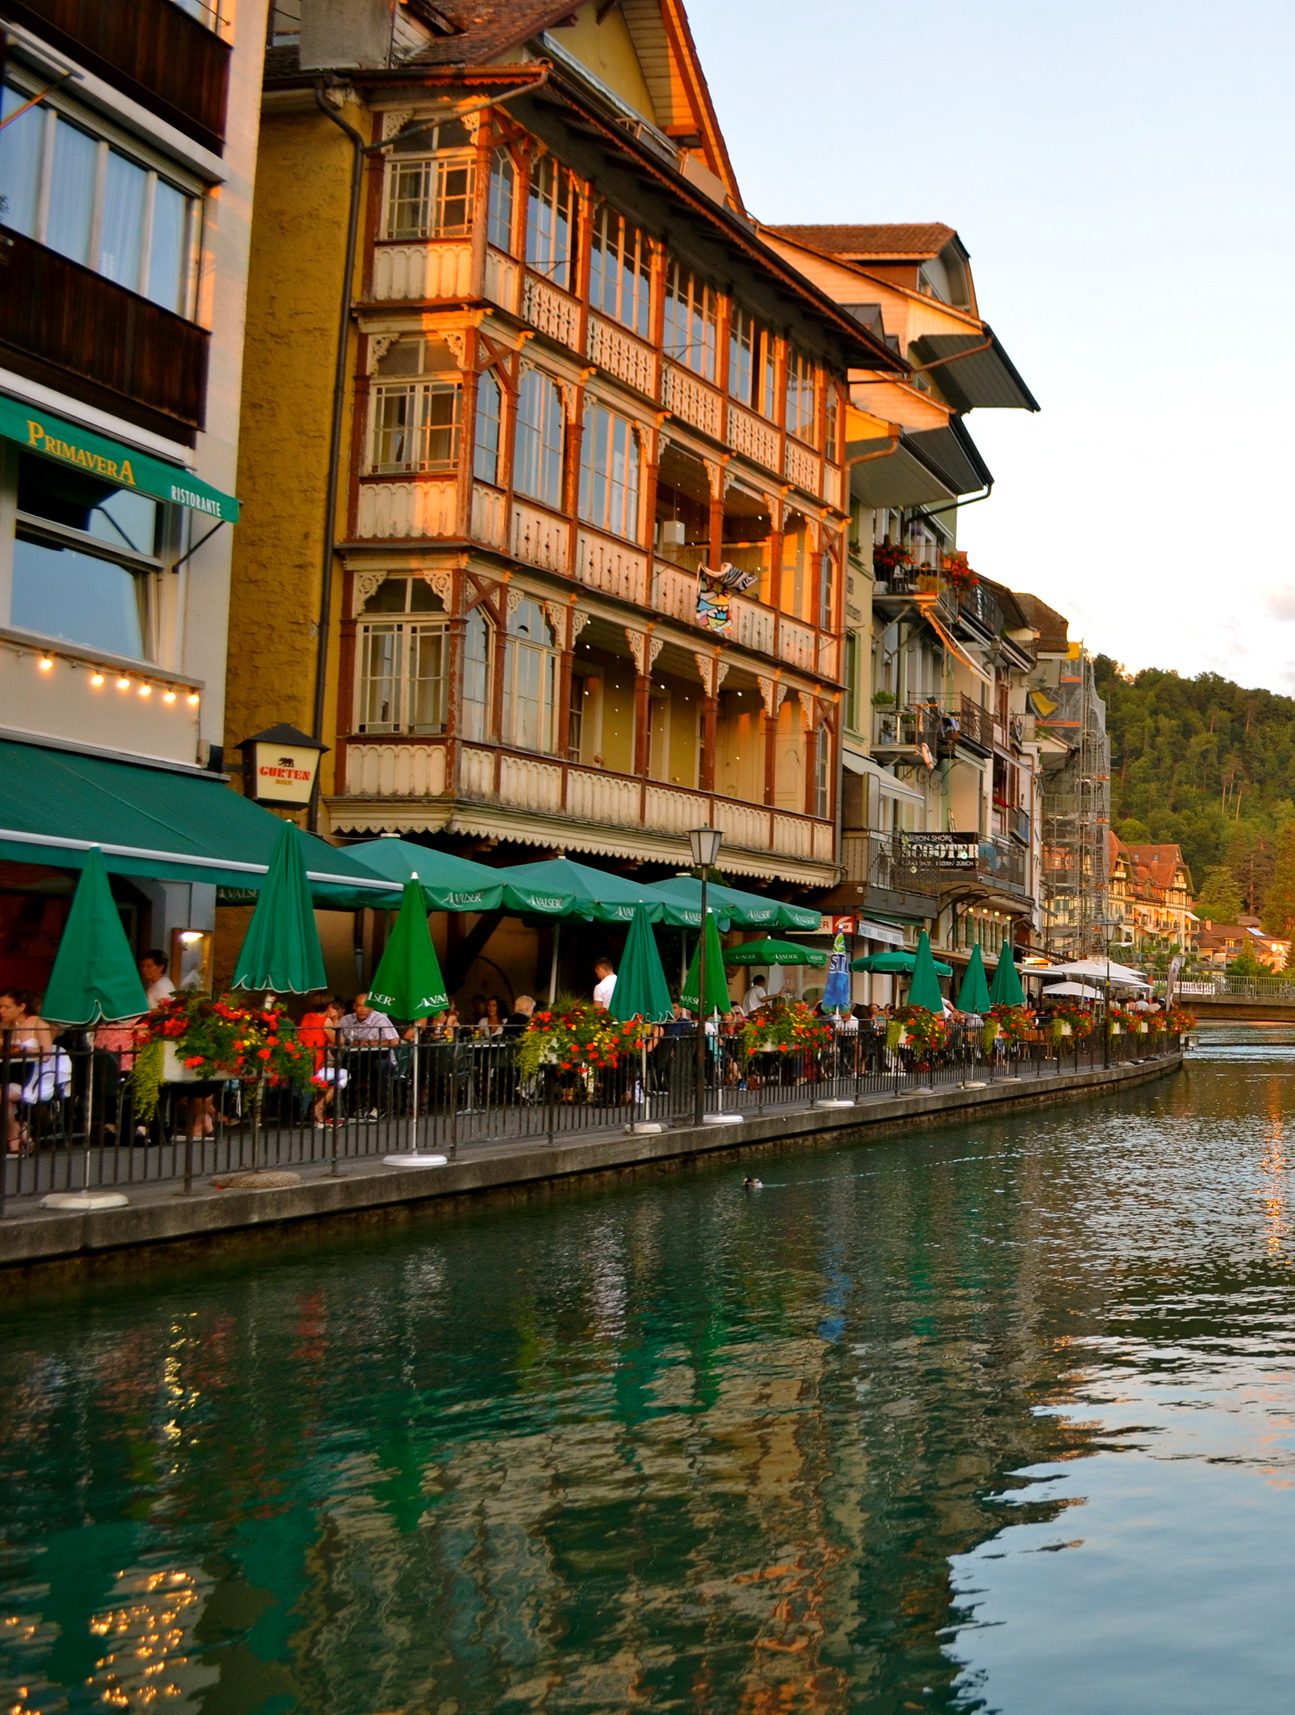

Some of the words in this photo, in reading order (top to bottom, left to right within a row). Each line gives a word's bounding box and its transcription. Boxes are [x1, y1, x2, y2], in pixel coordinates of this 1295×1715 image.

[27, 420, 136, 485] PRIMAVERA
[171, 485, 221, 517] RISTORANTE
[260, 766, 311, 781] GURTEN
[902, 843, 979, 858] SCOOTER
[228, 888, 259, 899] VALSE
[537, 897, 563, 909] VALSER
[367, 991, 392, 1006] LSER
